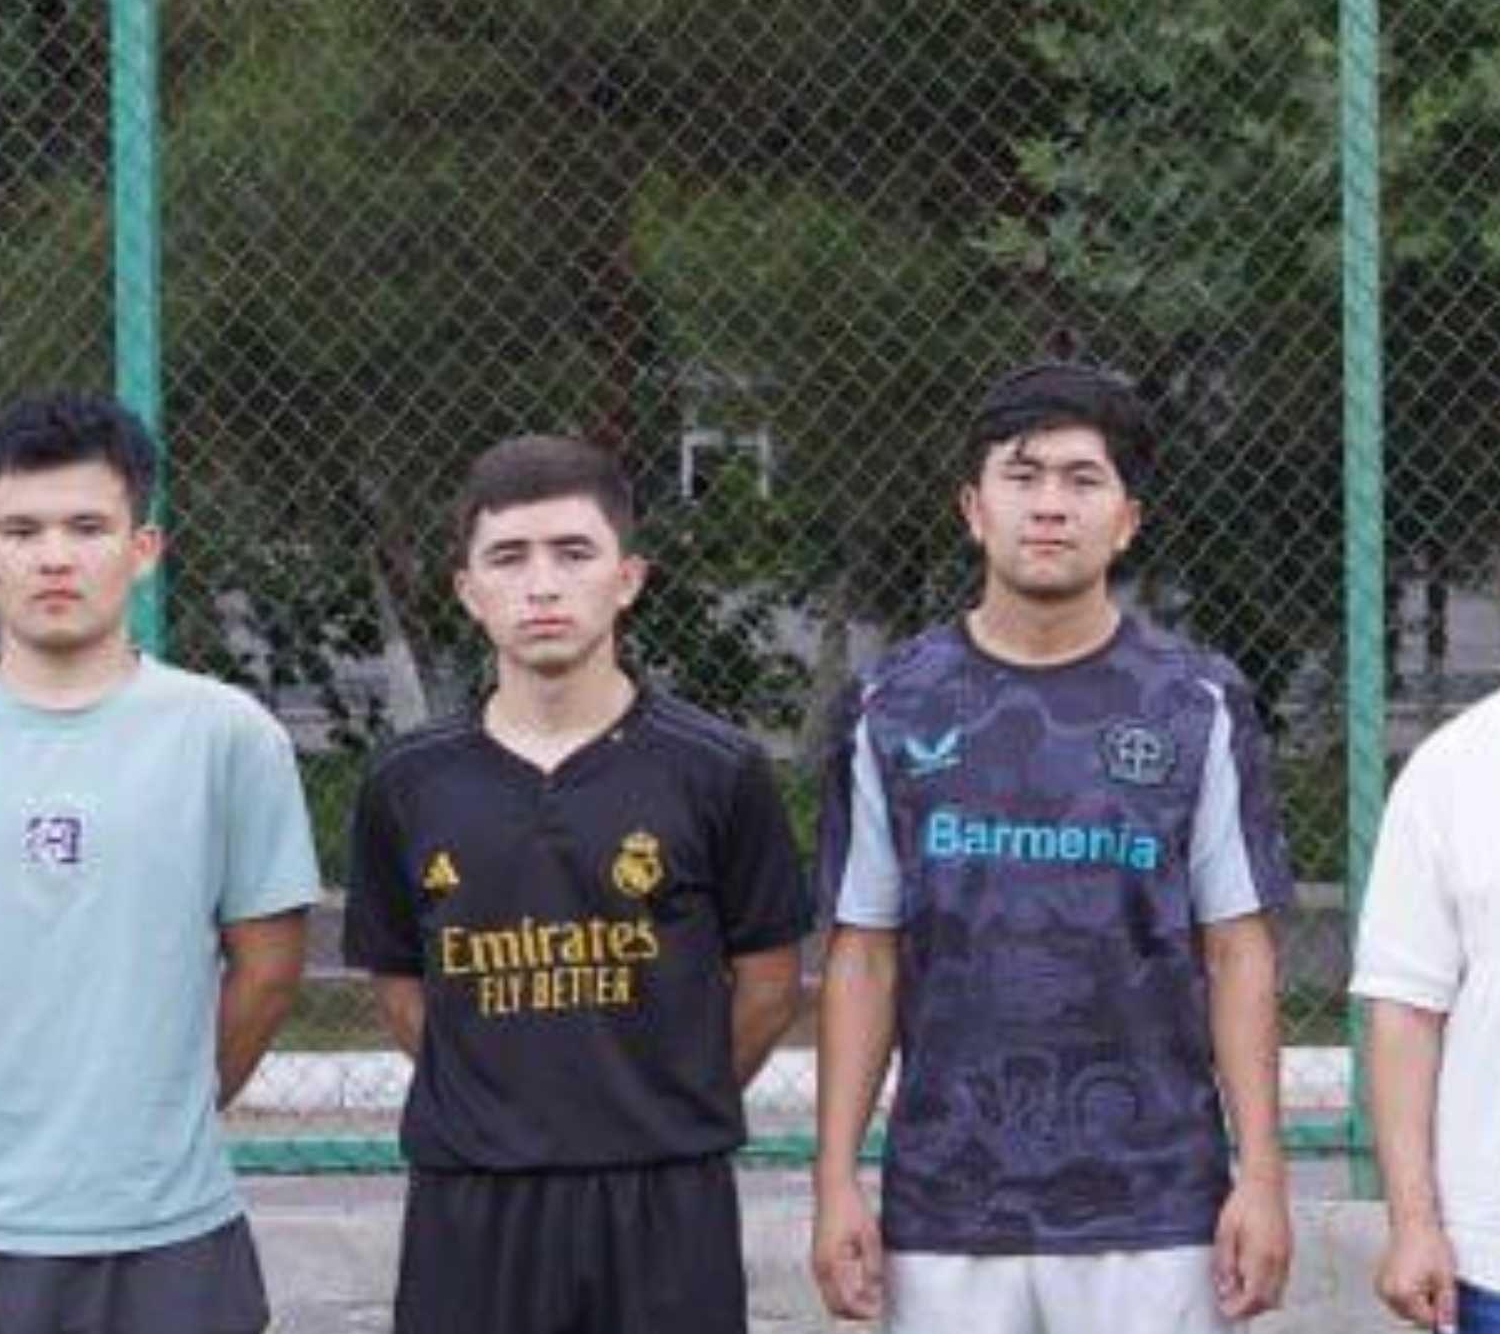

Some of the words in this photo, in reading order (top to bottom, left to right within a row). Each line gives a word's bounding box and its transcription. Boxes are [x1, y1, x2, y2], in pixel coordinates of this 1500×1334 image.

[925, 810, 1158, 870] Barmenia
[441, 916, 660, 975] Emirates
[478, 975, 524, 1017] FLY
